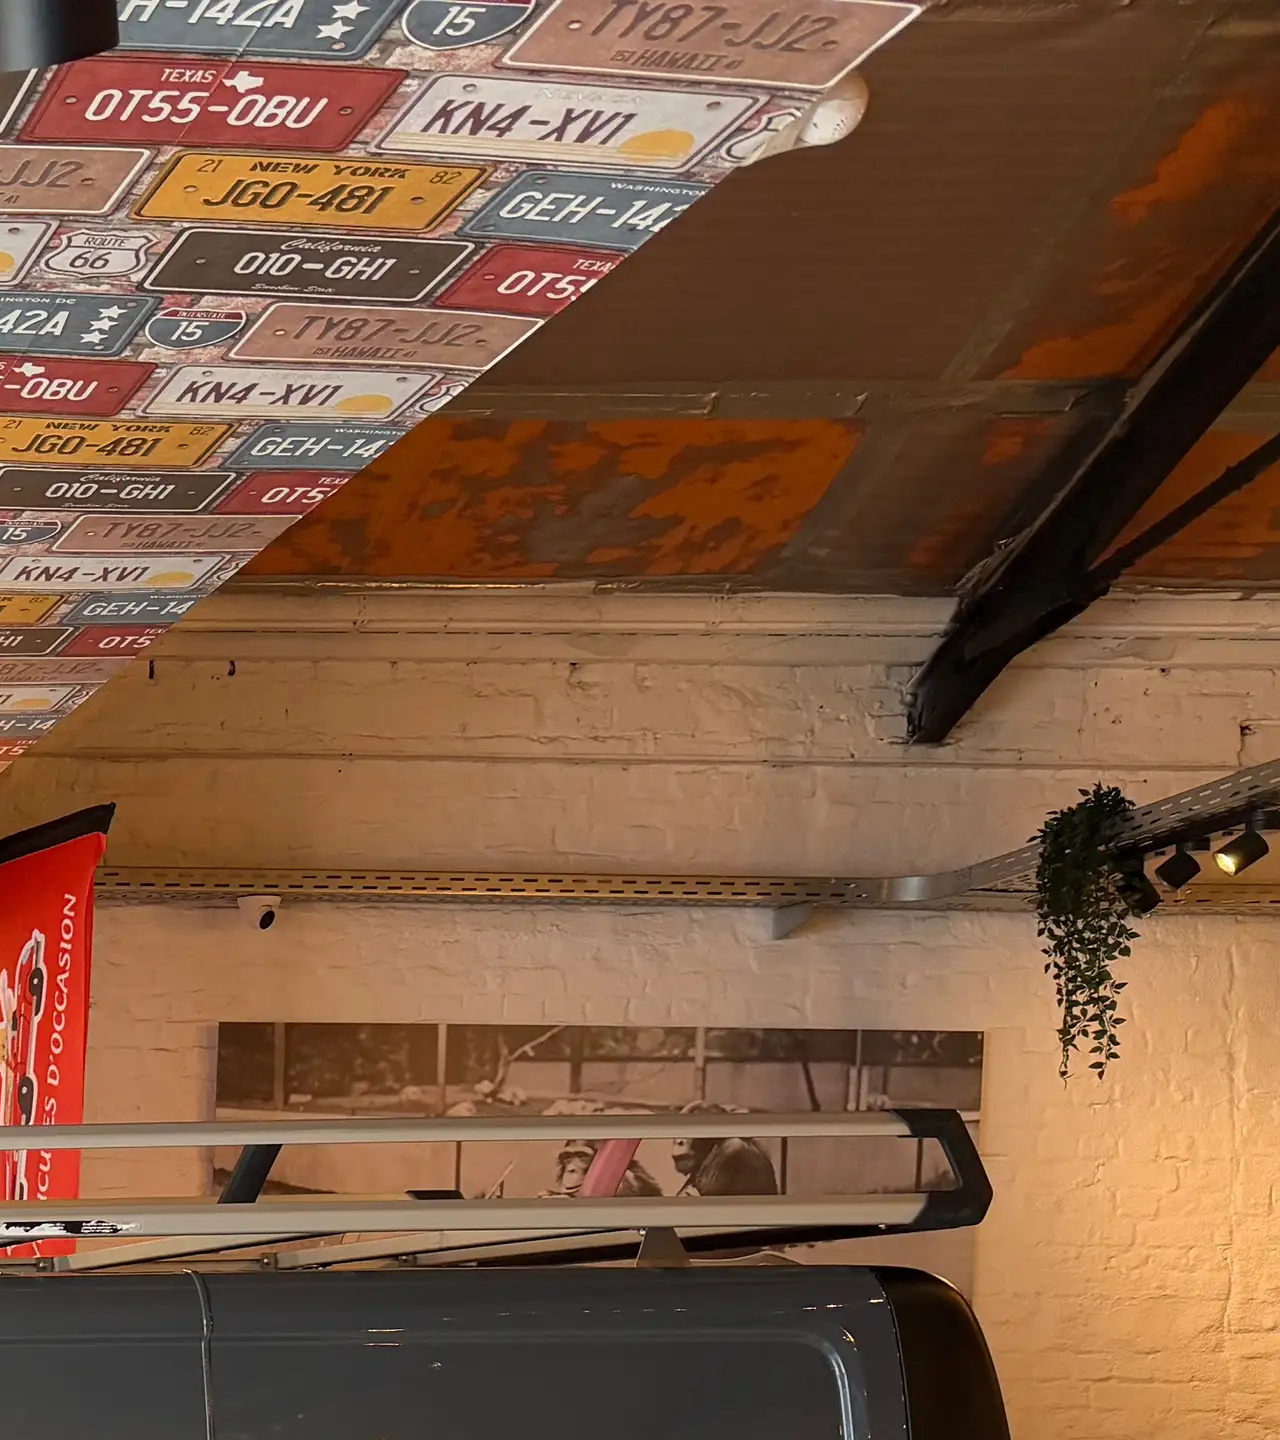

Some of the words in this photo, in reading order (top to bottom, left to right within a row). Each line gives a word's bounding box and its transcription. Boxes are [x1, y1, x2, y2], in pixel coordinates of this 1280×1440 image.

[156, 68, 219, 85] TEXAS
[194, 157, 225, 173] 21
[246, 160, 321, 176] NEW
[325, 163, 415, 180] YORK
[425, 169, 466, 185] 82
[277, 237, 387, 256] California
[64, 249, 118, 270] 66
[164, 320, 211, 343] 15
[172, 377, 346, 409] KN4-XV1
[46, 892, 78, 1087] D'OCCASION
